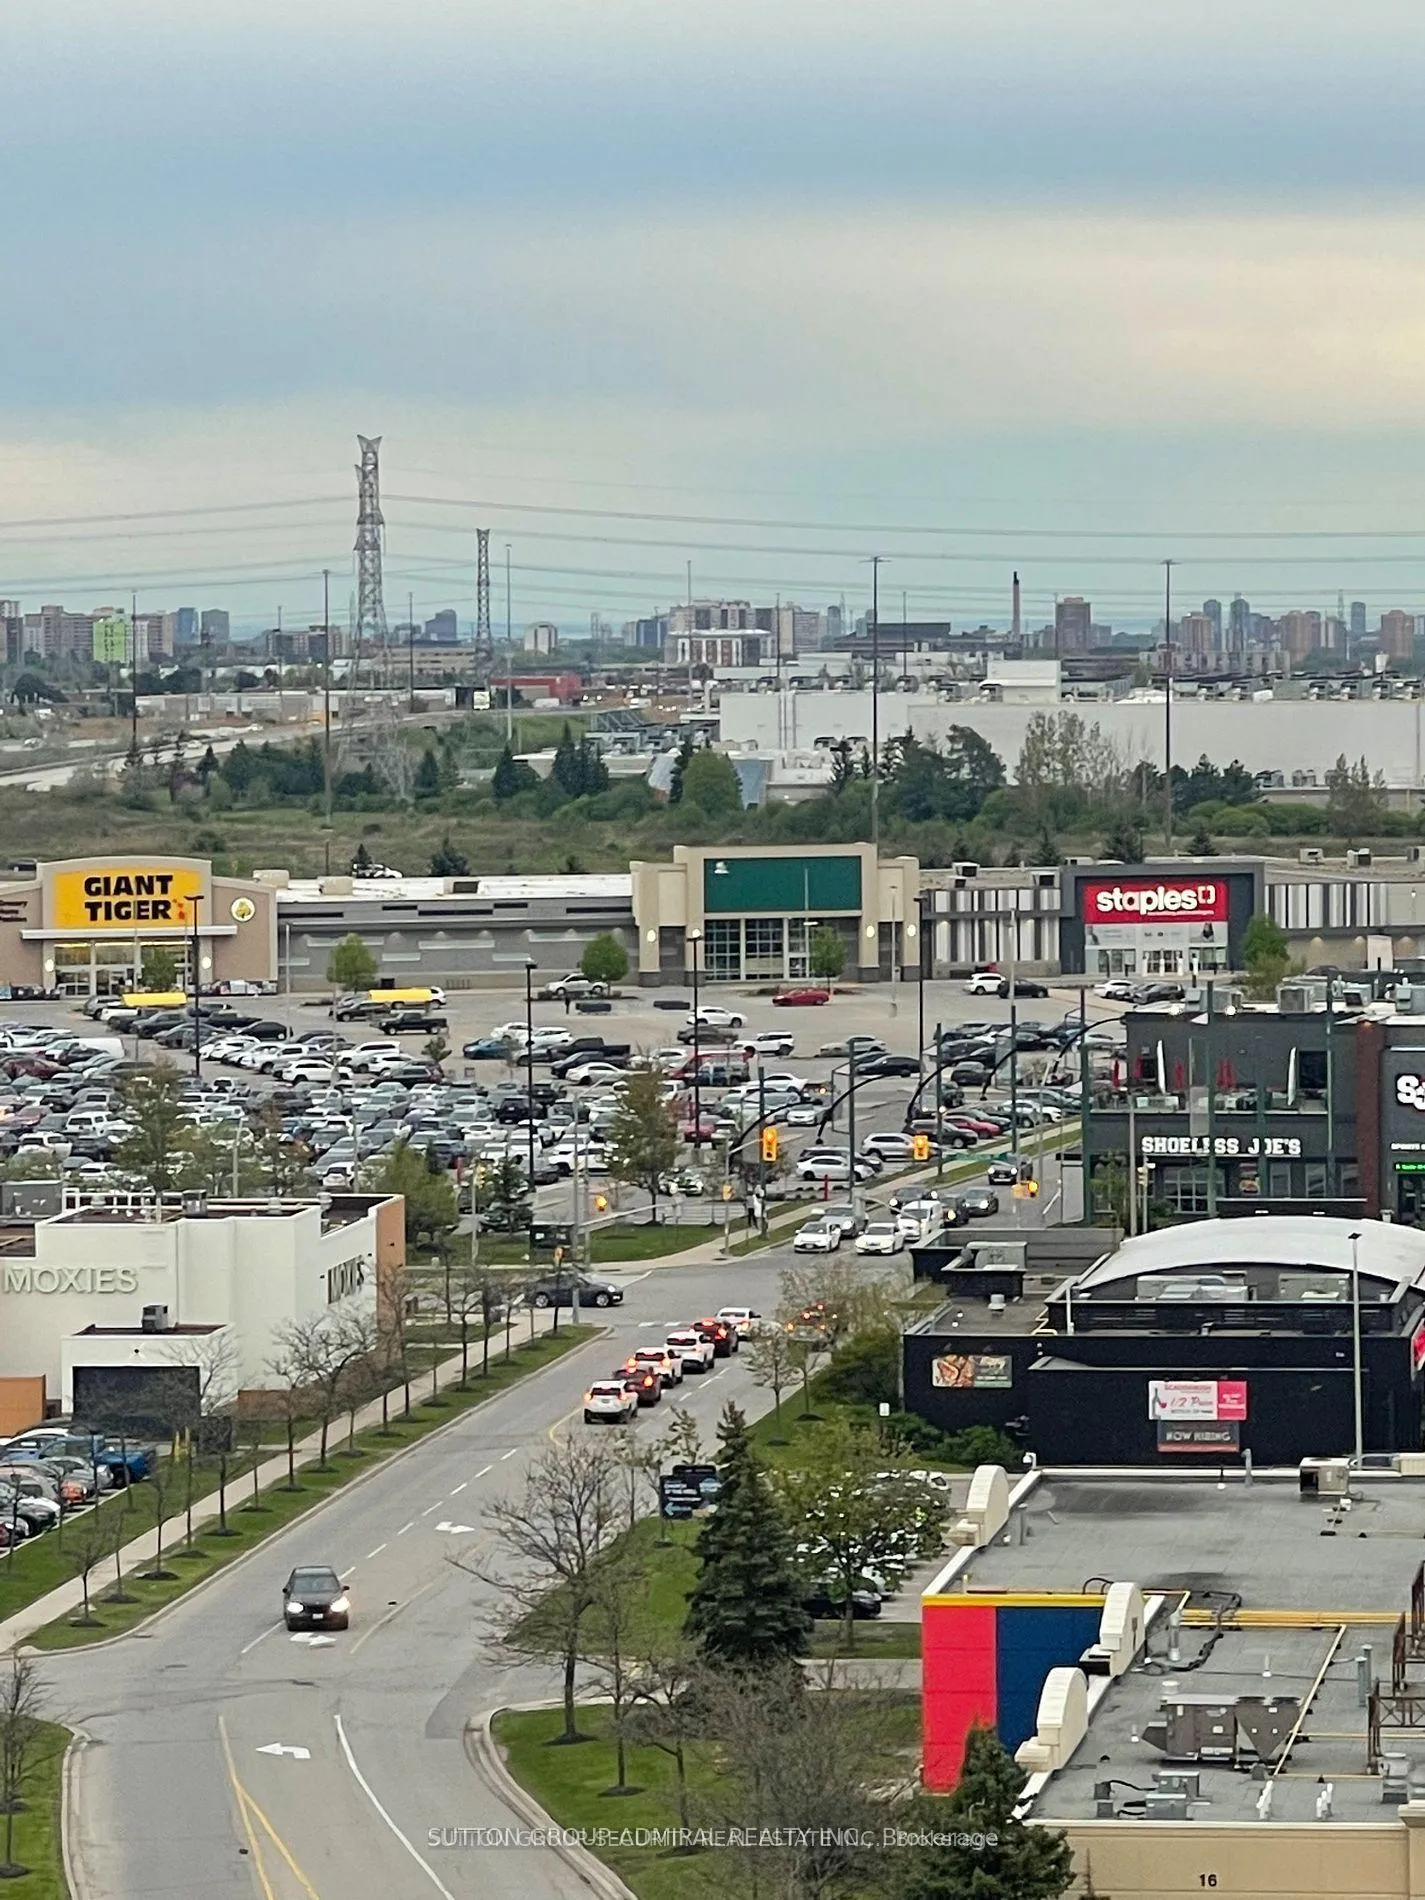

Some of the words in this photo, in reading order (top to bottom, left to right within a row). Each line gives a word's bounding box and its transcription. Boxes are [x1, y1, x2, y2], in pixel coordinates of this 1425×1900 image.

[84, 875, 173, 896] GIANT
[84, 899, 172, 921] TIGER
[1096, 885, 1198, 915] staples
[3, 1267, 139, 1294] MOXIES
[1199, 1874, 1217, 1887] 16
